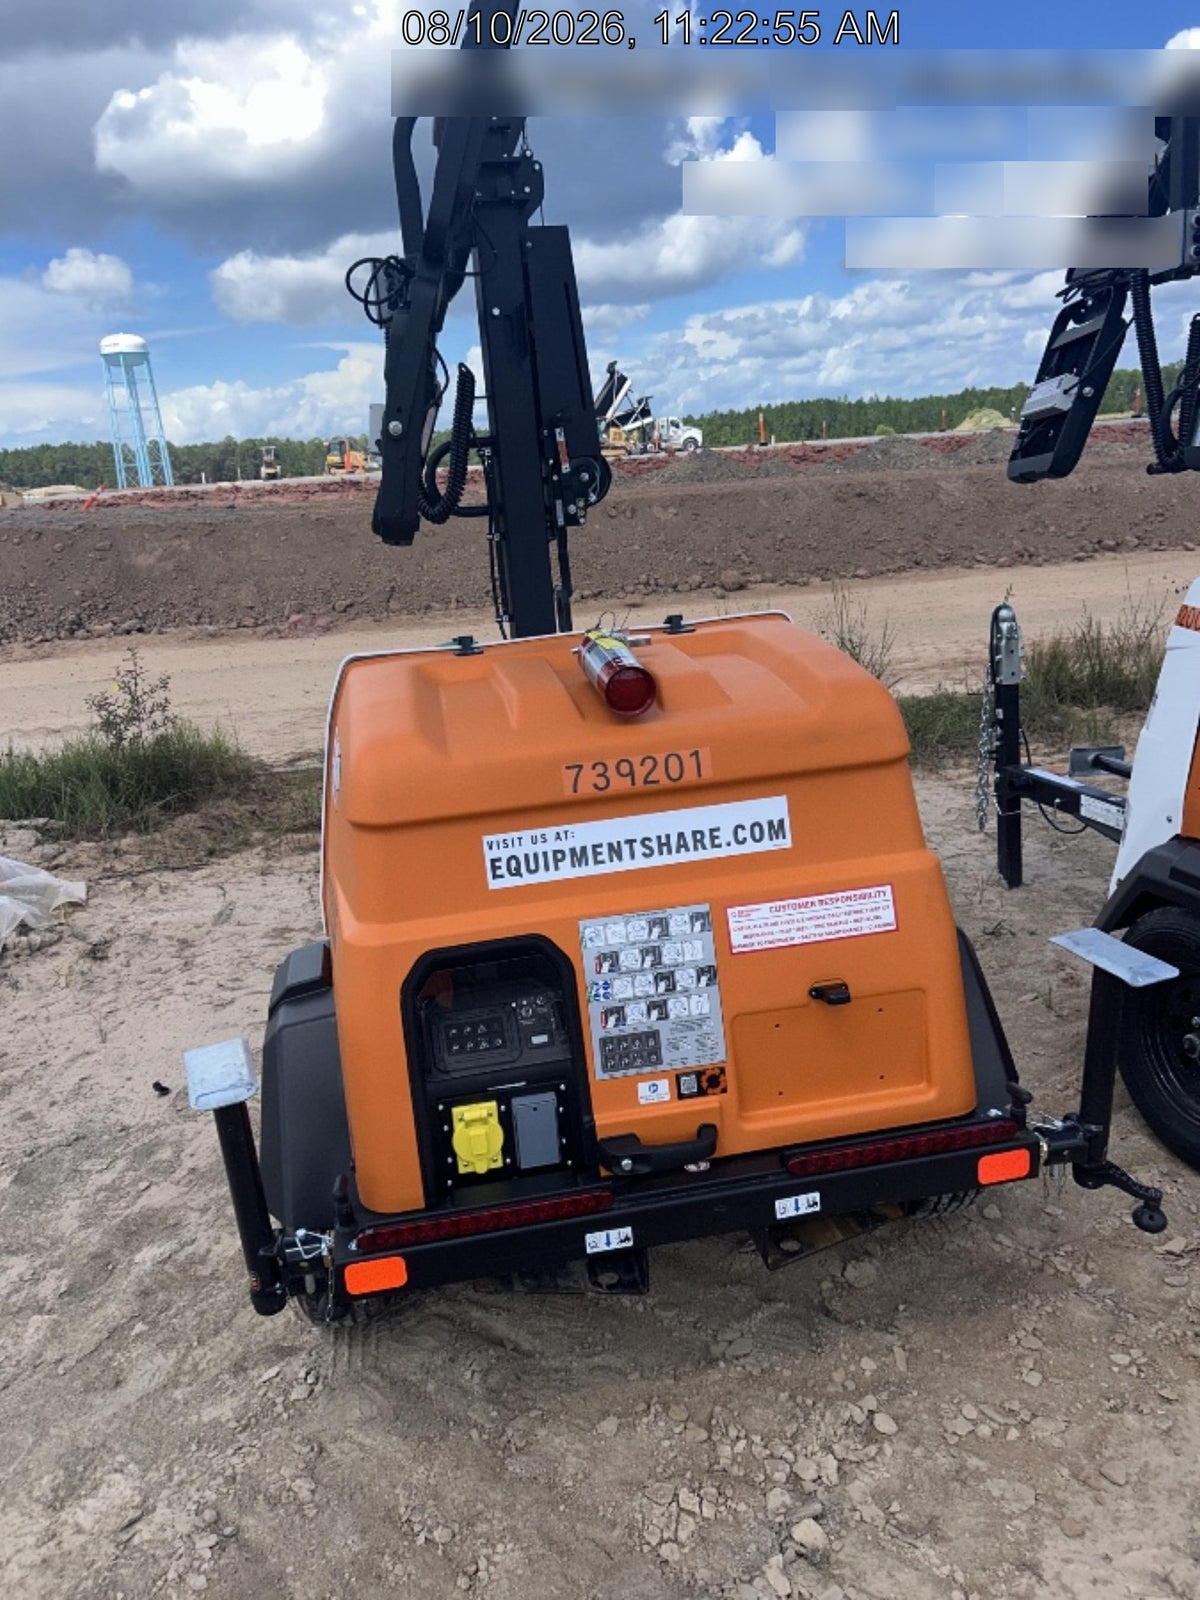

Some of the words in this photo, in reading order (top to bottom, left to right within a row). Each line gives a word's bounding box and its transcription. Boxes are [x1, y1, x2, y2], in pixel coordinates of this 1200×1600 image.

[565, 750, 703, 793] 739201
[486, 836, 522, 850] VISIT
[531, 834, 548, 844] US
[554, 830, 576, 841] AT:
[490, 817, 787, 880] EQUIPMENTSHARE.COM
[769, 900, 817, 913] CUSTOMER
